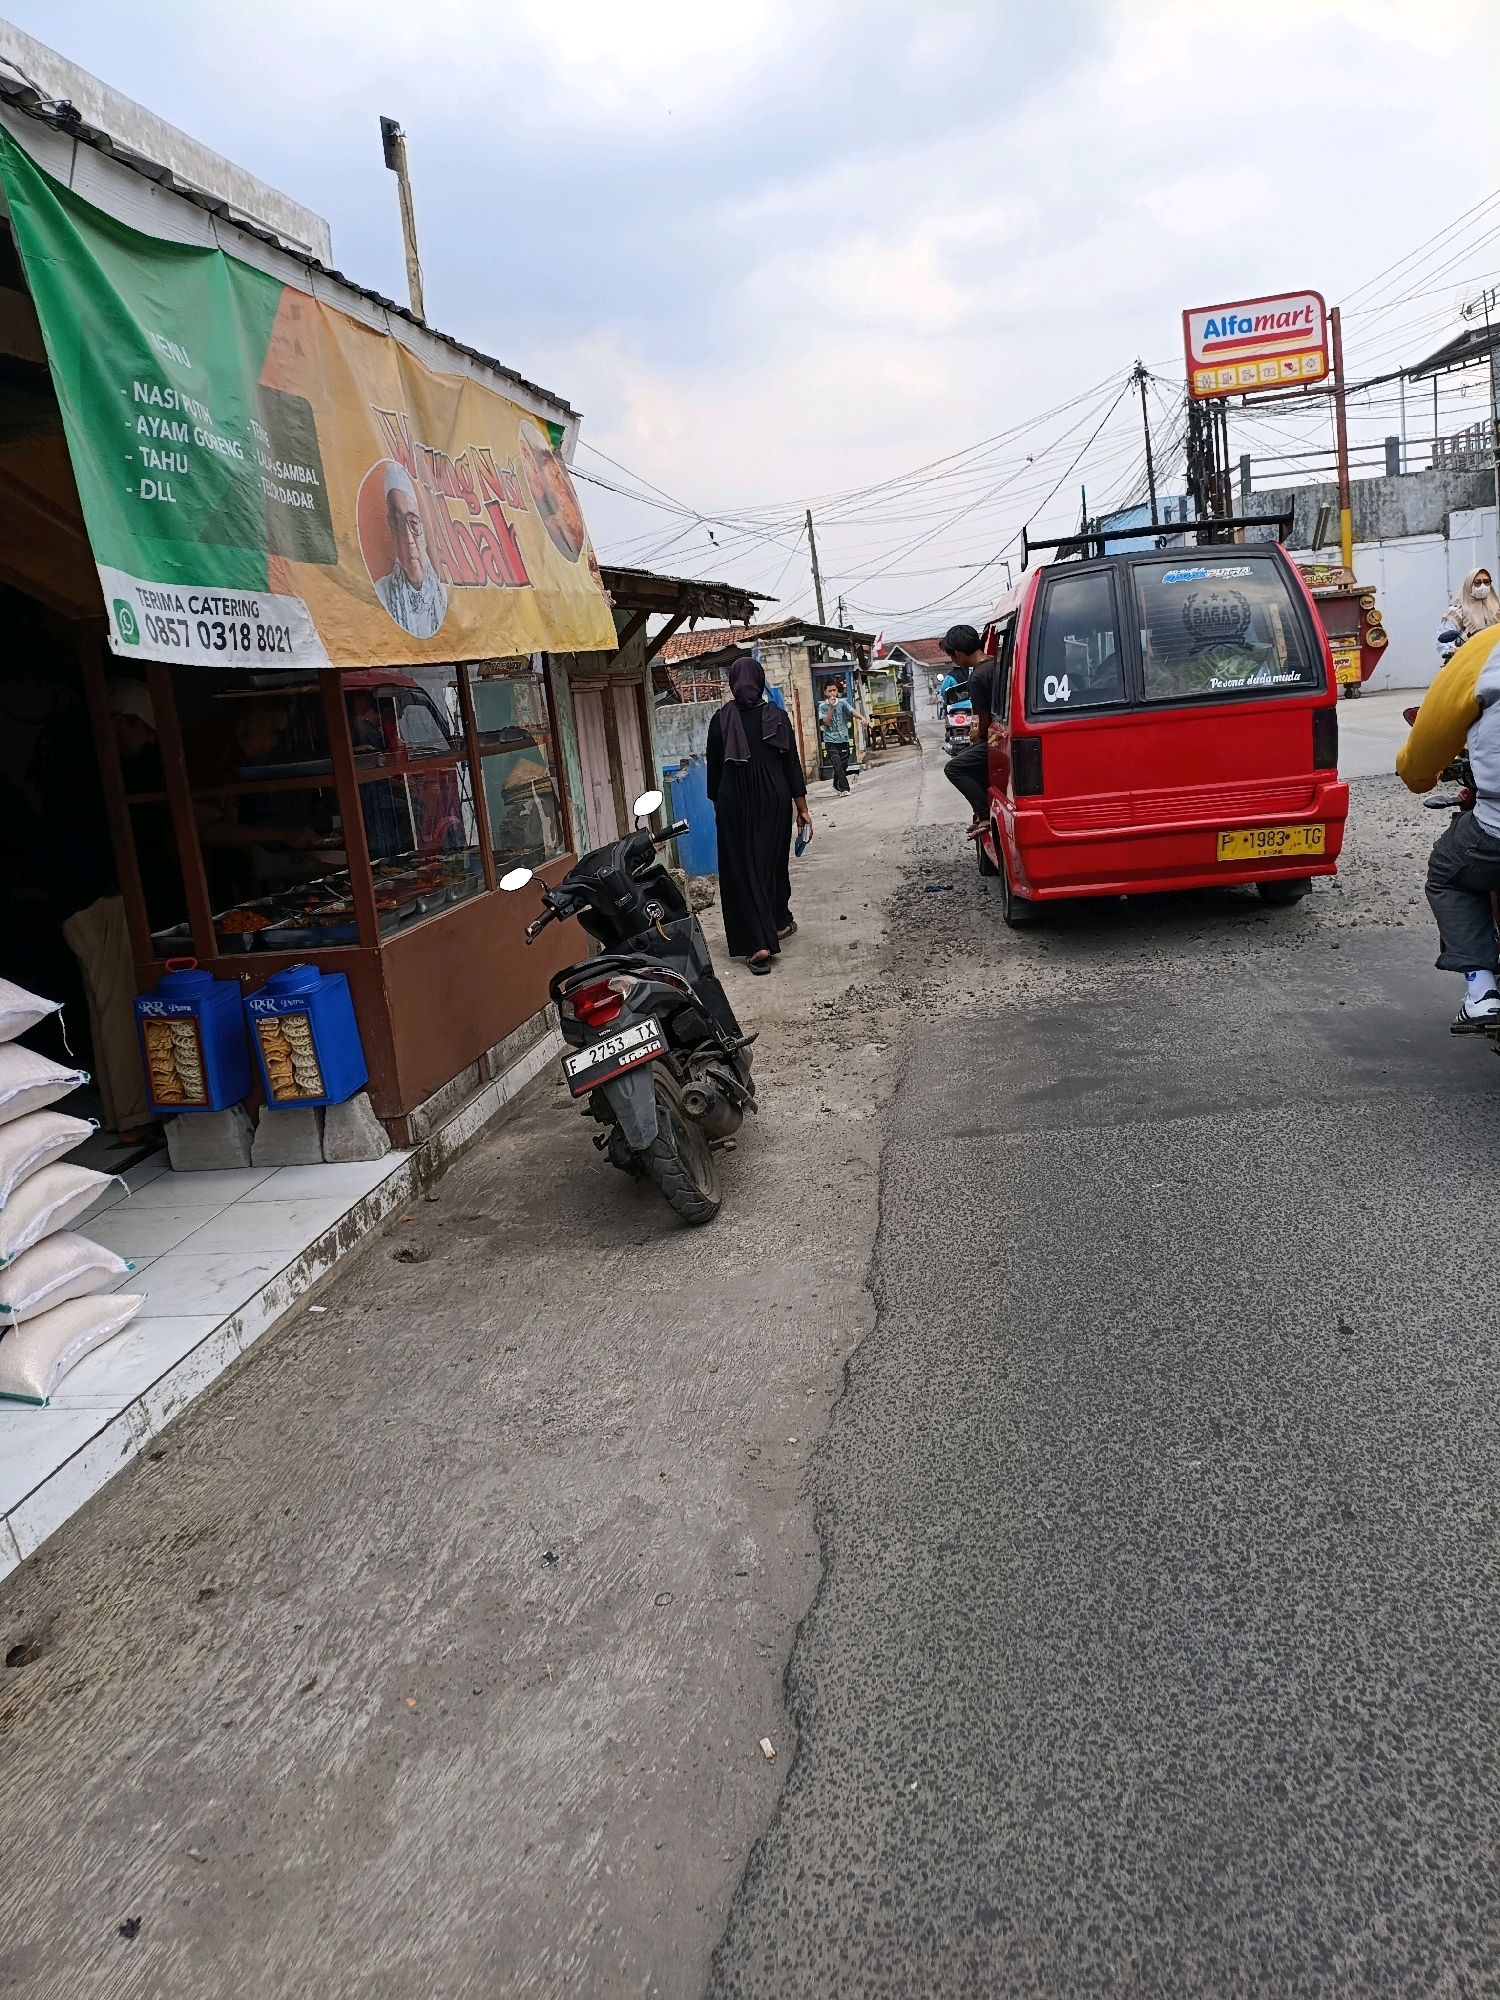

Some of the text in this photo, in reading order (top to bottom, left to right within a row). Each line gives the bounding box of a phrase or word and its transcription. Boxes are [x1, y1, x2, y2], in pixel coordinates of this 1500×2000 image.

[1203, 305, 1314, 339] Alfamart
[133, 381, 213, 425] NASI PUTIH
[136, 415, 244, 460] AYAM GORENG
[139, 446, 188, 474] TAHU
[140, 479, 177, 503] DLL
[278, 487, 315, 510] DADAR
[135, 587, 260, 618] TERIMA CATERING
[1193, 604, 1241, 628] BAGAS
[145, 613, 292, 653] 0857 0318 8021
[1044, 674, 1071, 702] 04
[1221, 828, 1322, 851] F 1983 TG
[569, 1059, 577, 1075] F
[589, 1037, 624, 1064] 2753
[636, 1022, 655, 1040] TX
